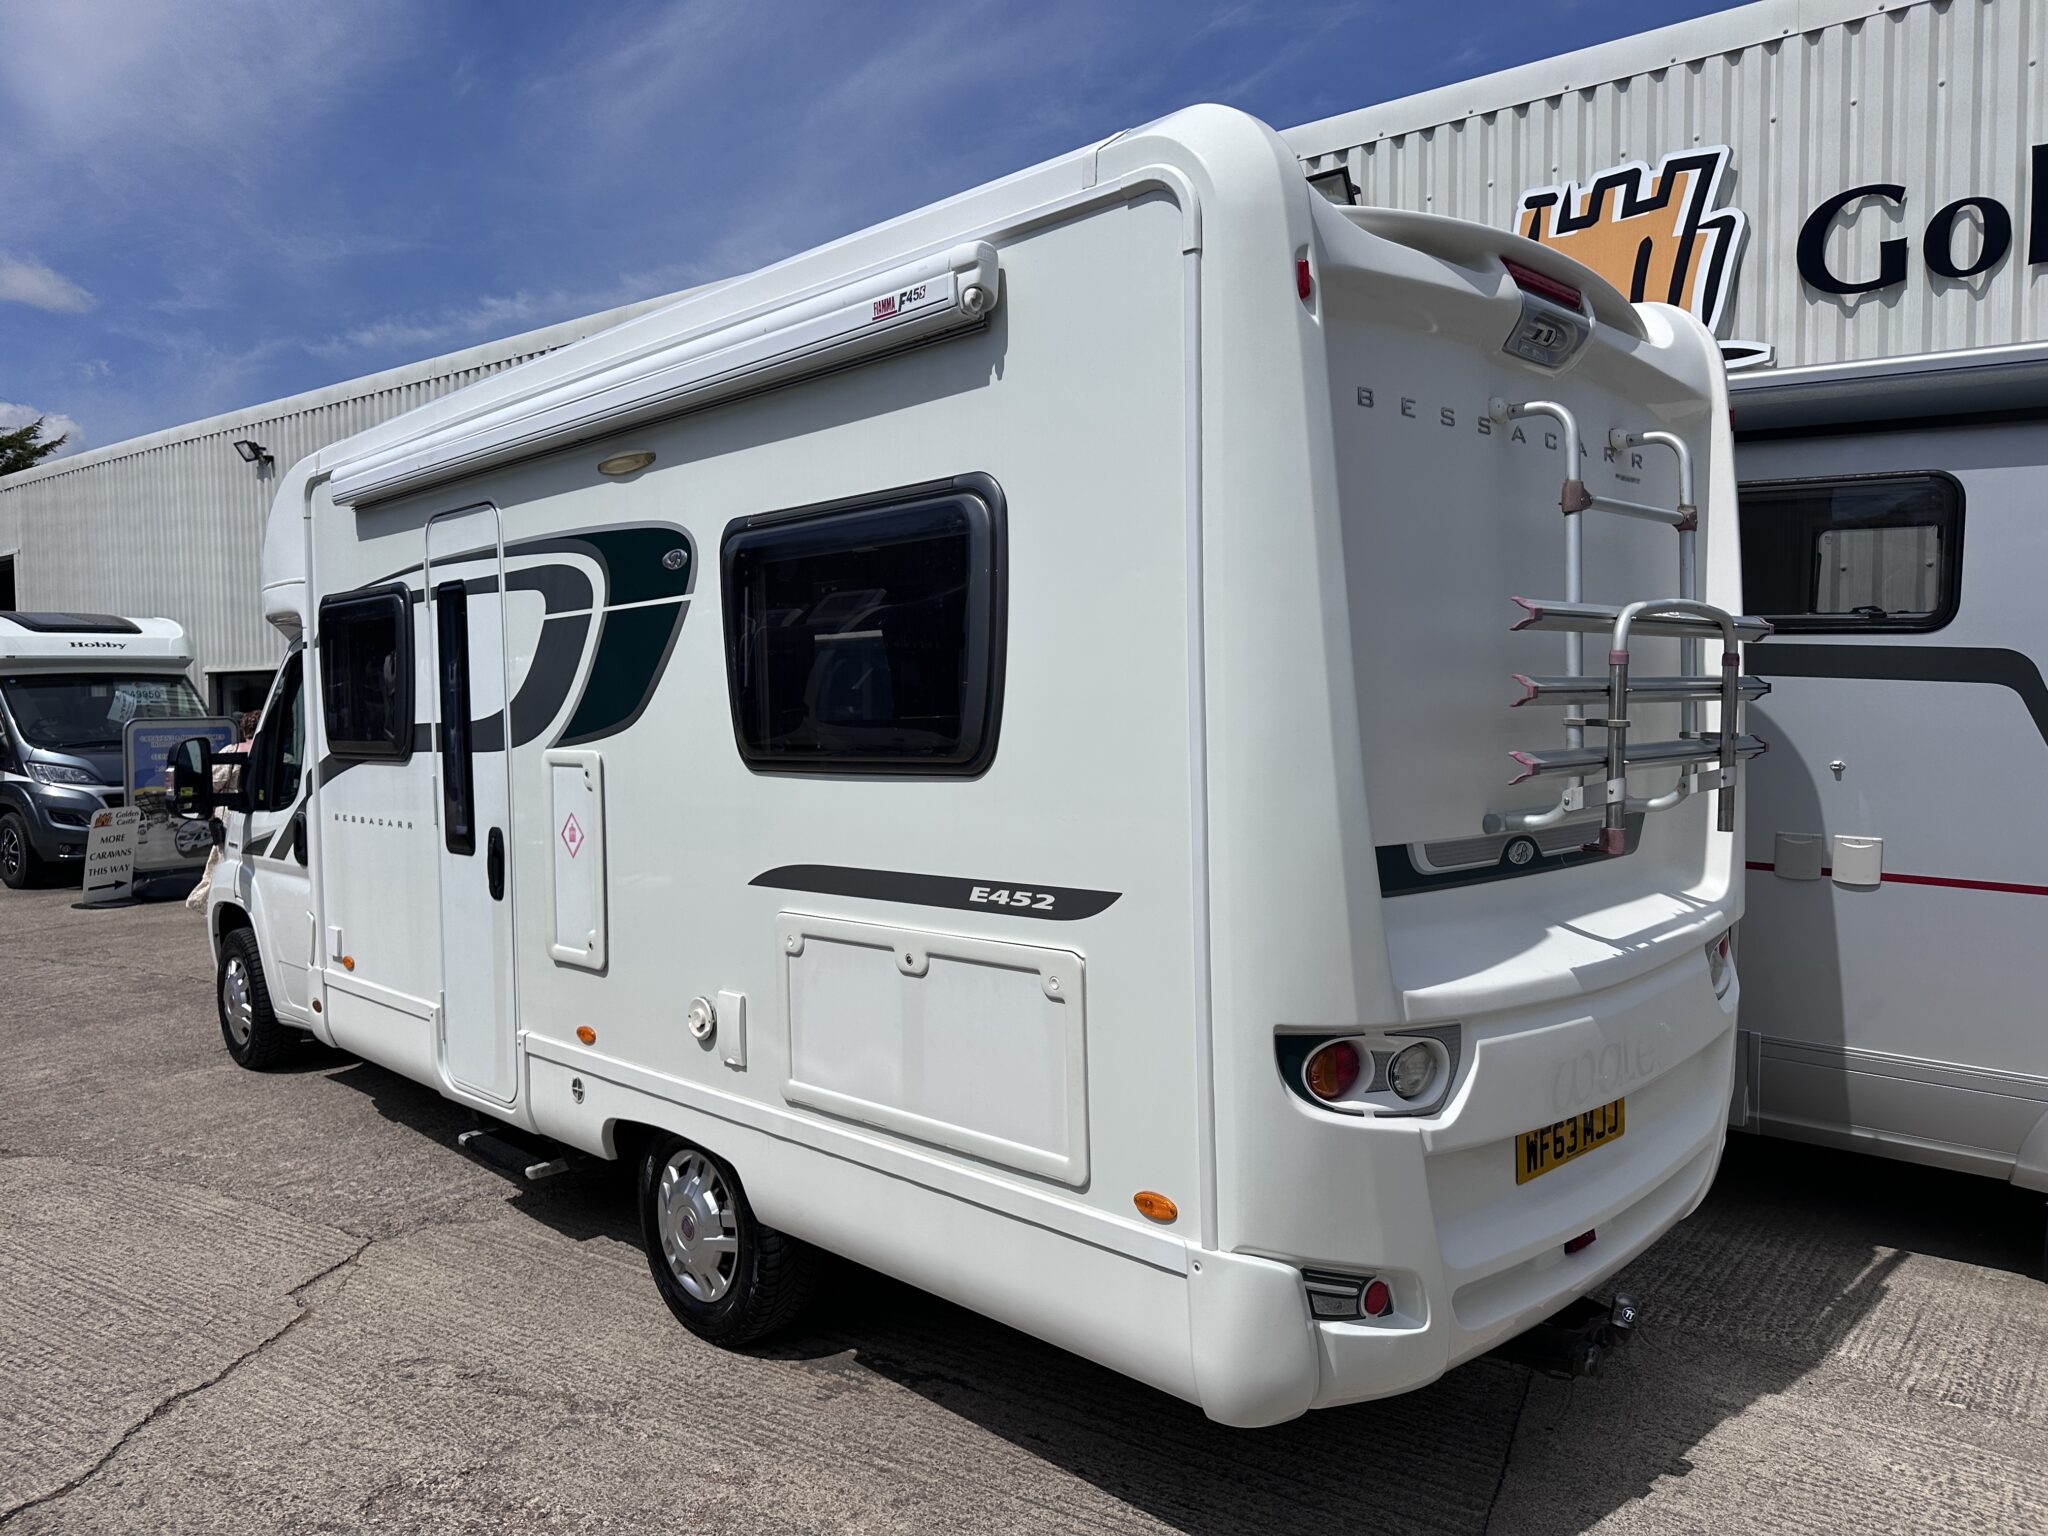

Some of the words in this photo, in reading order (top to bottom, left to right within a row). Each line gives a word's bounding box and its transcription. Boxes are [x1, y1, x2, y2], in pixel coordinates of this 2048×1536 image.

[872, 295, 896, 317] FIAMMA
[1356, 385, 1643, 469] BESSACARR
[69, 641, 127, 650] Hobby
[115, 809, 140, 819] Golden
[116, 817, 137, 826] Castle
[334, 813, 413, 830] BESSACARR
[100, 833, 126, 844] MORE
[89, 847, 133, 861] CARAVANS
[88, 866, 108, 877] THIS
[109, 863, 130, 873] WAY
[969, 886, 1056, 910] E452
[1525, 1116, 1578, 1174] WF63
[1583, 1100, 1618, 1147] MJJ
